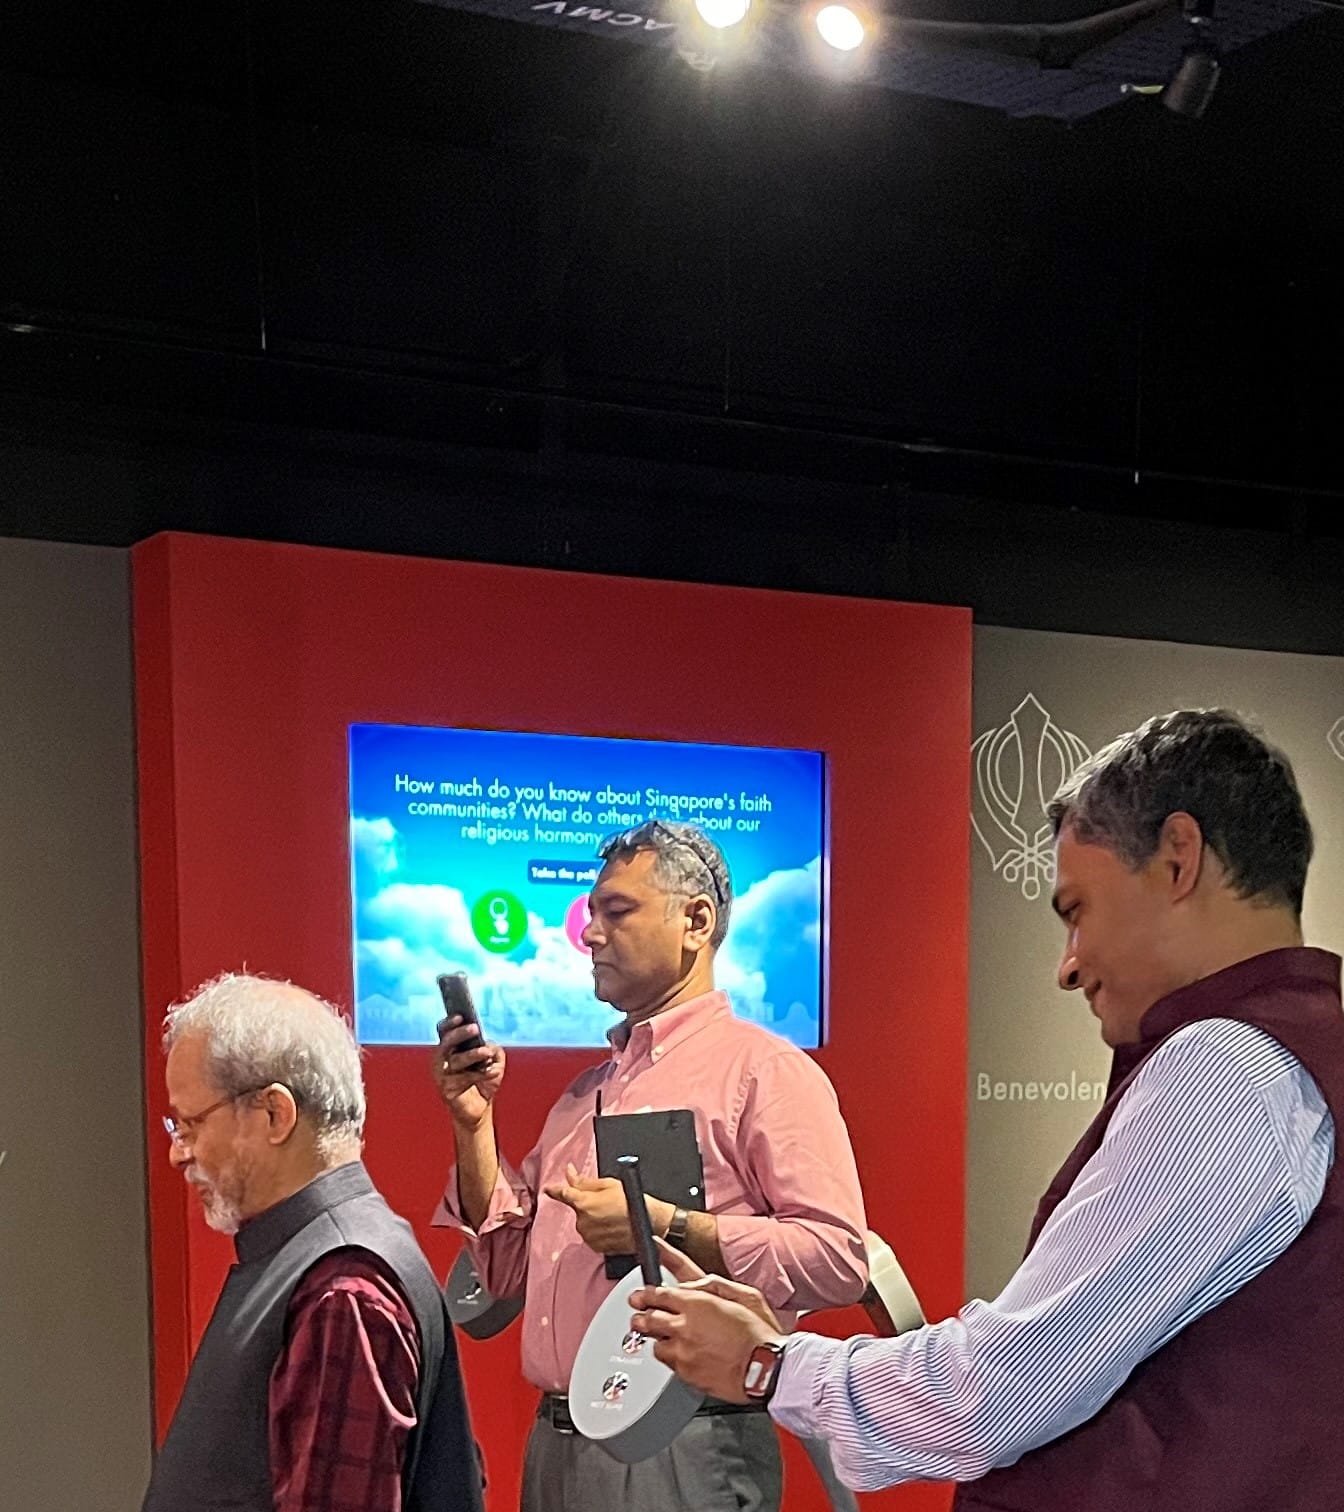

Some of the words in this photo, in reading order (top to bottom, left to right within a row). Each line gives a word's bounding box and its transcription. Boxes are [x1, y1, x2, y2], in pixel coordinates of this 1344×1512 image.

[531, 1, 677, 31] ACMV
[394, 773, 435, 794] How
[440, 776, 483, 797] much
[488, 778, 510, 798] do
[514, 786, 544, 803] you
[549, 781, 592, 802] know
[596, 785, 641, 805] about
[645, 788, 736, 813] Singapore's
[740, 792, 772, 812] faith
[408, 800, 517, 820] communities?
[522, 802, 567, 823] What
[571, 804, 593, 824] do
[597, 807, 643, 826] others
[736, 818, 761, 832] our
[461, 820, 529, 845] religious
[535, 823, 603, 846] harmony
[531, 866, 557, 879] Take
[558, 867, 575, 879] the
